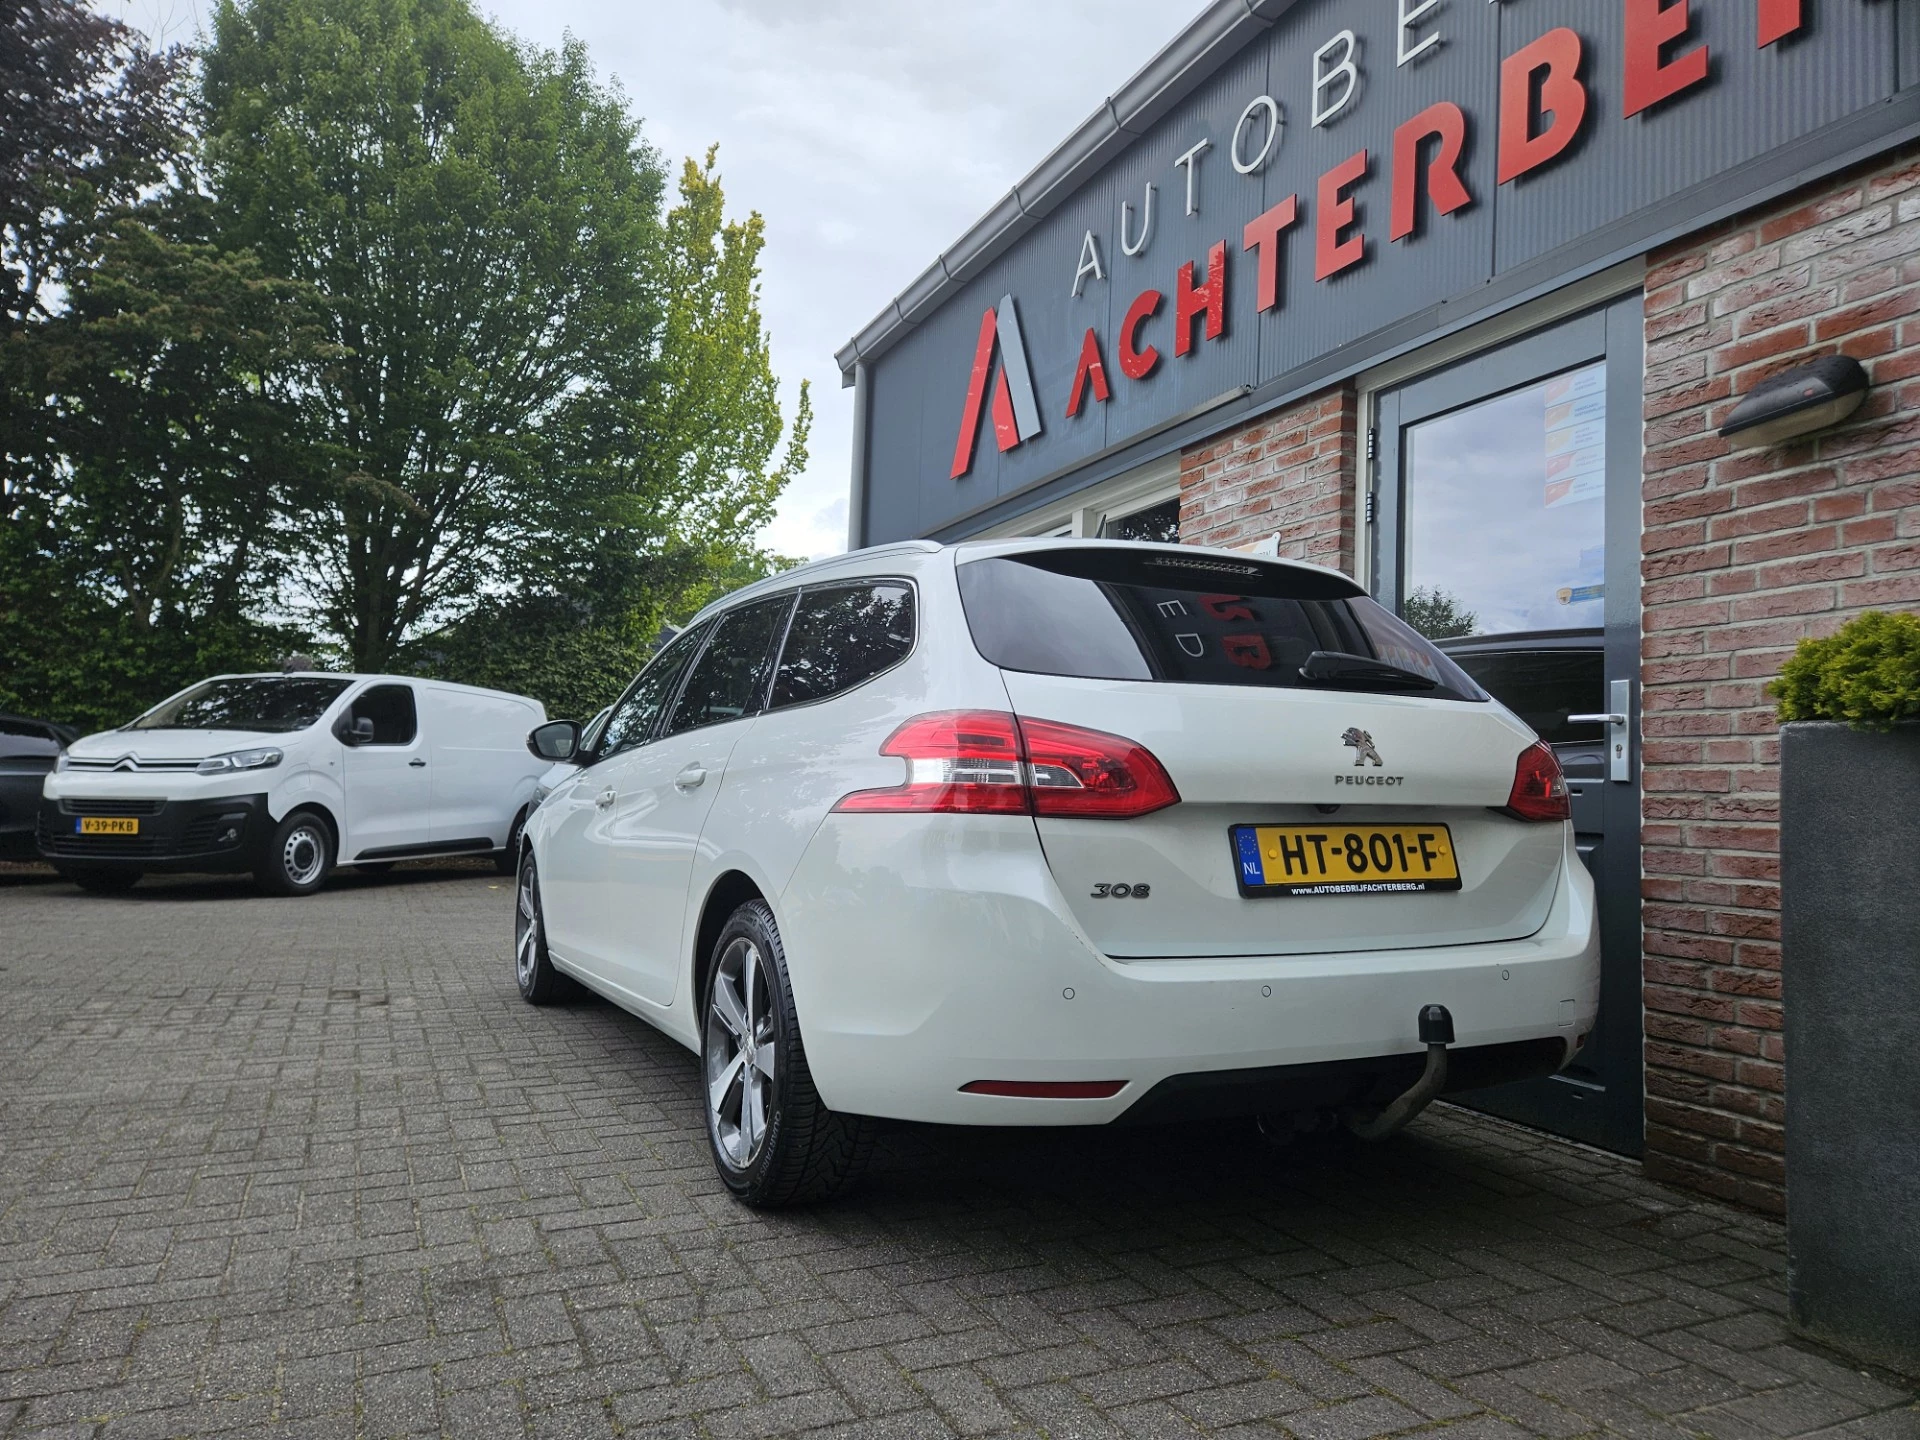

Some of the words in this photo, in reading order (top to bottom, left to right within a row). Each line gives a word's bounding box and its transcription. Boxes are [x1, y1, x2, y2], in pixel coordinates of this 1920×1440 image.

[1071, 0, 1500, 299] AUTOBE
[1334, 775, 1404, 786] PEUGEOT
[1279, 832, 1438, 876] HT-801-F
[1243, 862, 1261, 875] NL
[1090, 883, 1151, 899] 308
[1291, 882, 1425, 895] www.AUTOBEDRIJFACHTERBERG.nl
